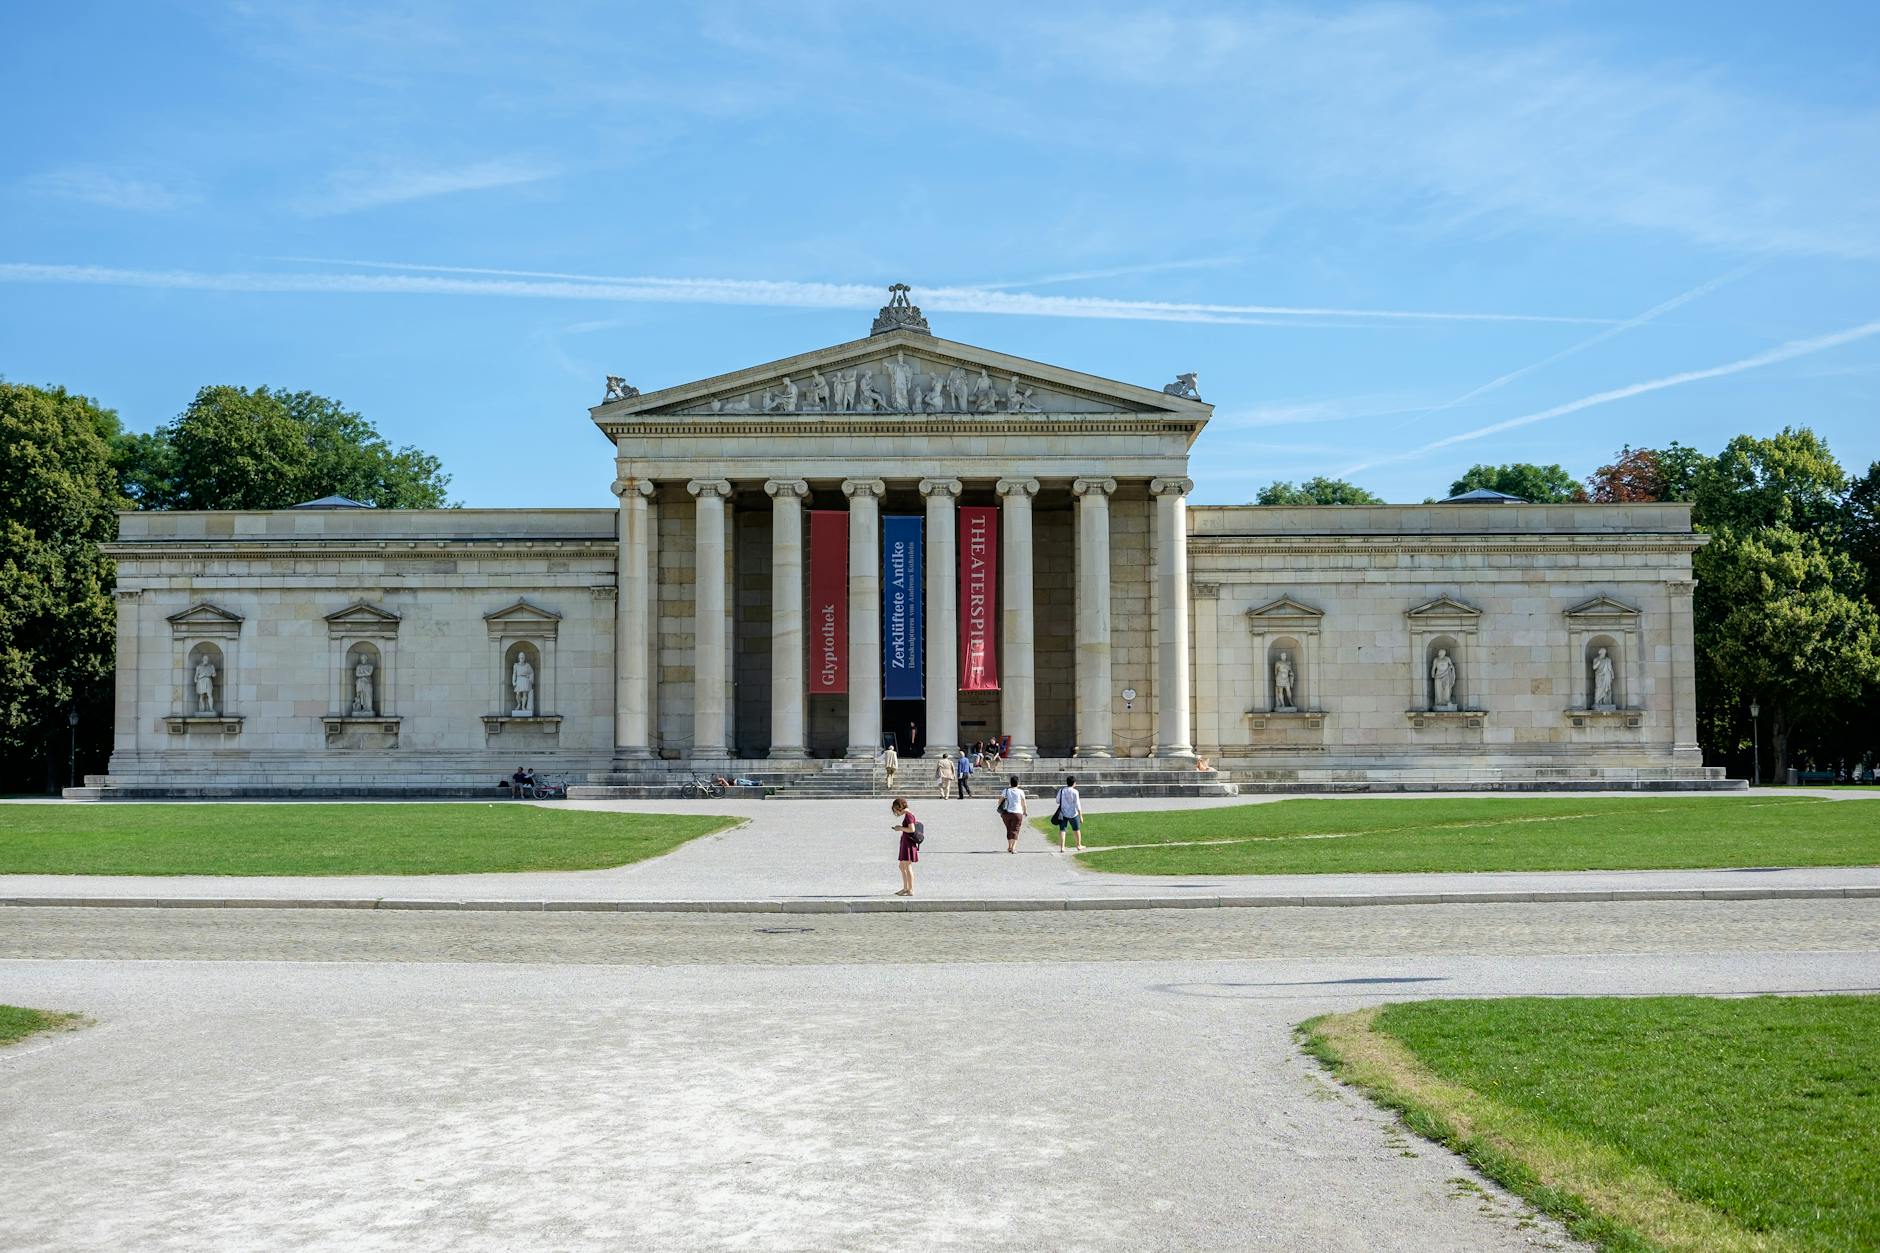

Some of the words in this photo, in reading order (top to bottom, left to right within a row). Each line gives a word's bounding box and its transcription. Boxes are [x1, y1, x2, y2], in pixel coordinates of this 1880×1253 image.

[892, 541, 905, 588] Antike
[971, 515, 986, 677] THEATERSPIELE
[822, 604, 838, 686] Glyptothek
[892, 592, 905, 669] Zerklüftete
